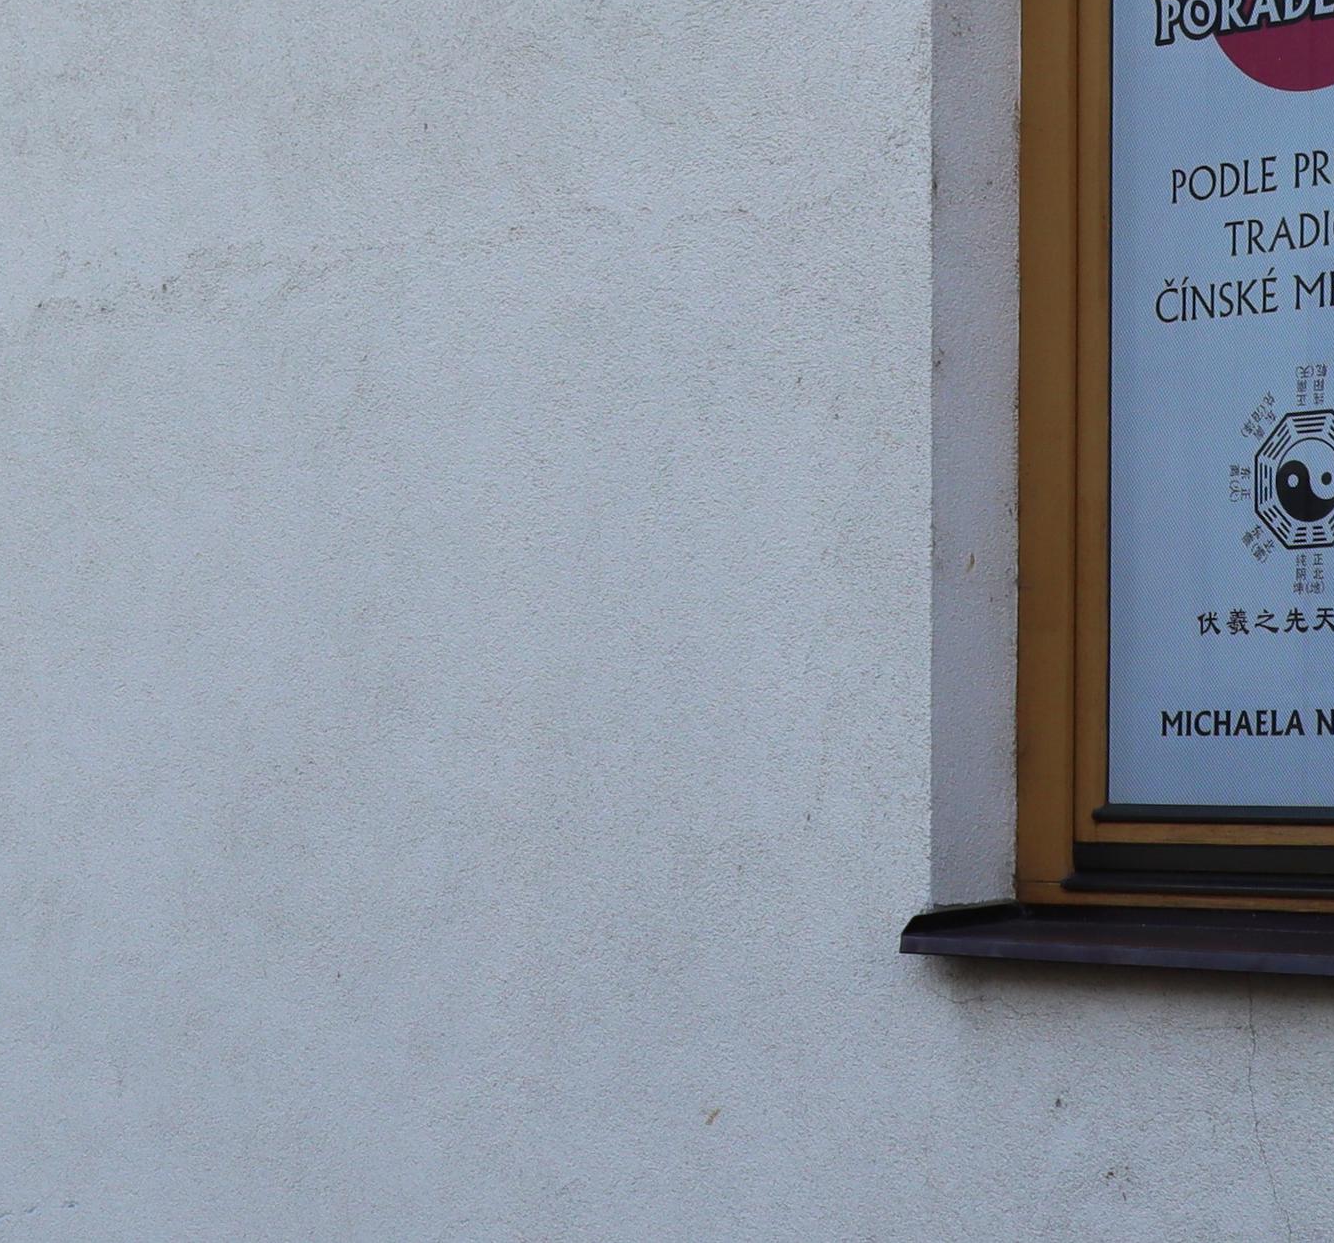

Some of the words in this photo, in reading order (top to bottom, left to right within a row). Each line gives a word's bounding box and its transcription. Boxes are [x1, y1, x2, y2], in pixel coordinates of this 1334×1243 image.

[1171, 156, 1279, 205] PODLE
[1155, 267, 1279, 324] ČÍNSKÉ
[1161, 709, 1305, 737] MICHAELA
